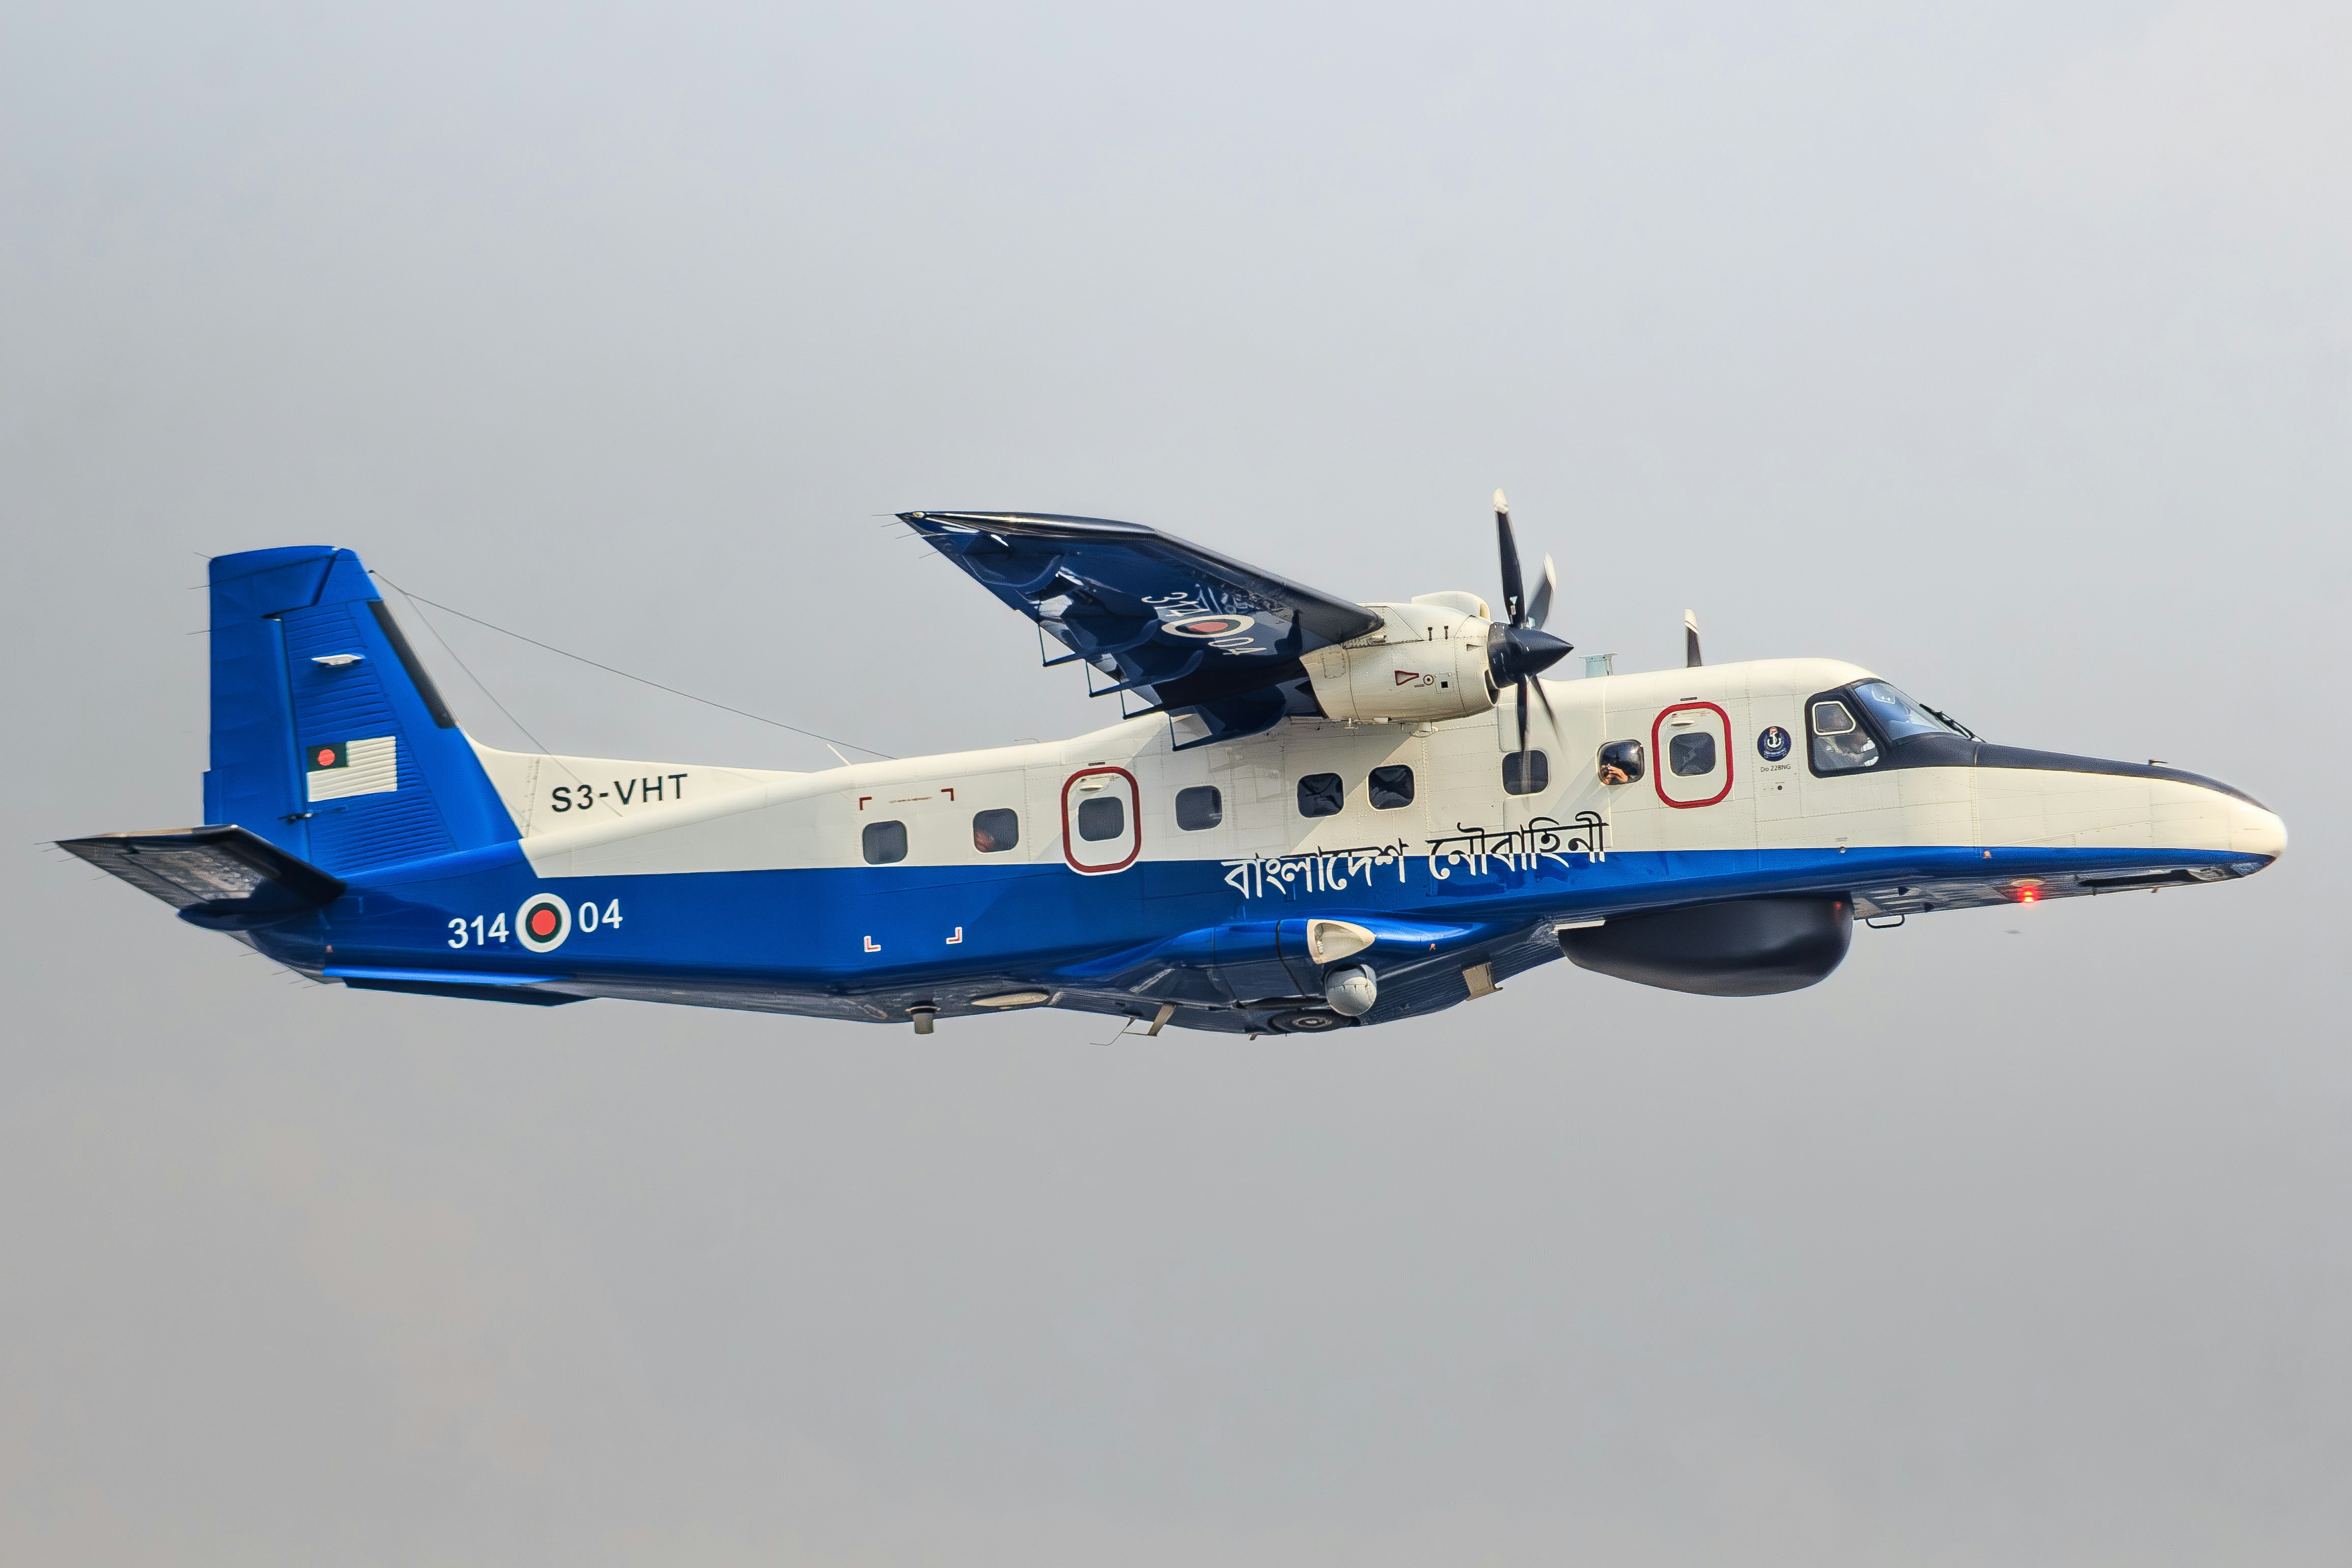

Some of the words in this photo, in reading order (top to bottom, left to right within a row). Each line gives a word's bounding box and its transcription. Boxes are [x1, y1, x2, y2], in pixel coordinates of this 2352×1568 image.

[1141, 592, 1211, 617] 314
[1208, 637, 1267, 655] 04
[551, 773, 688, 813] S3-VHT
[1221, 838, 1409, 899] বাংলাদেশ
[1425, 810, 1610, 880] নৌবাহিনী
[448, 912, 509, 948] 314
[578, 899, 623, 933] 04
